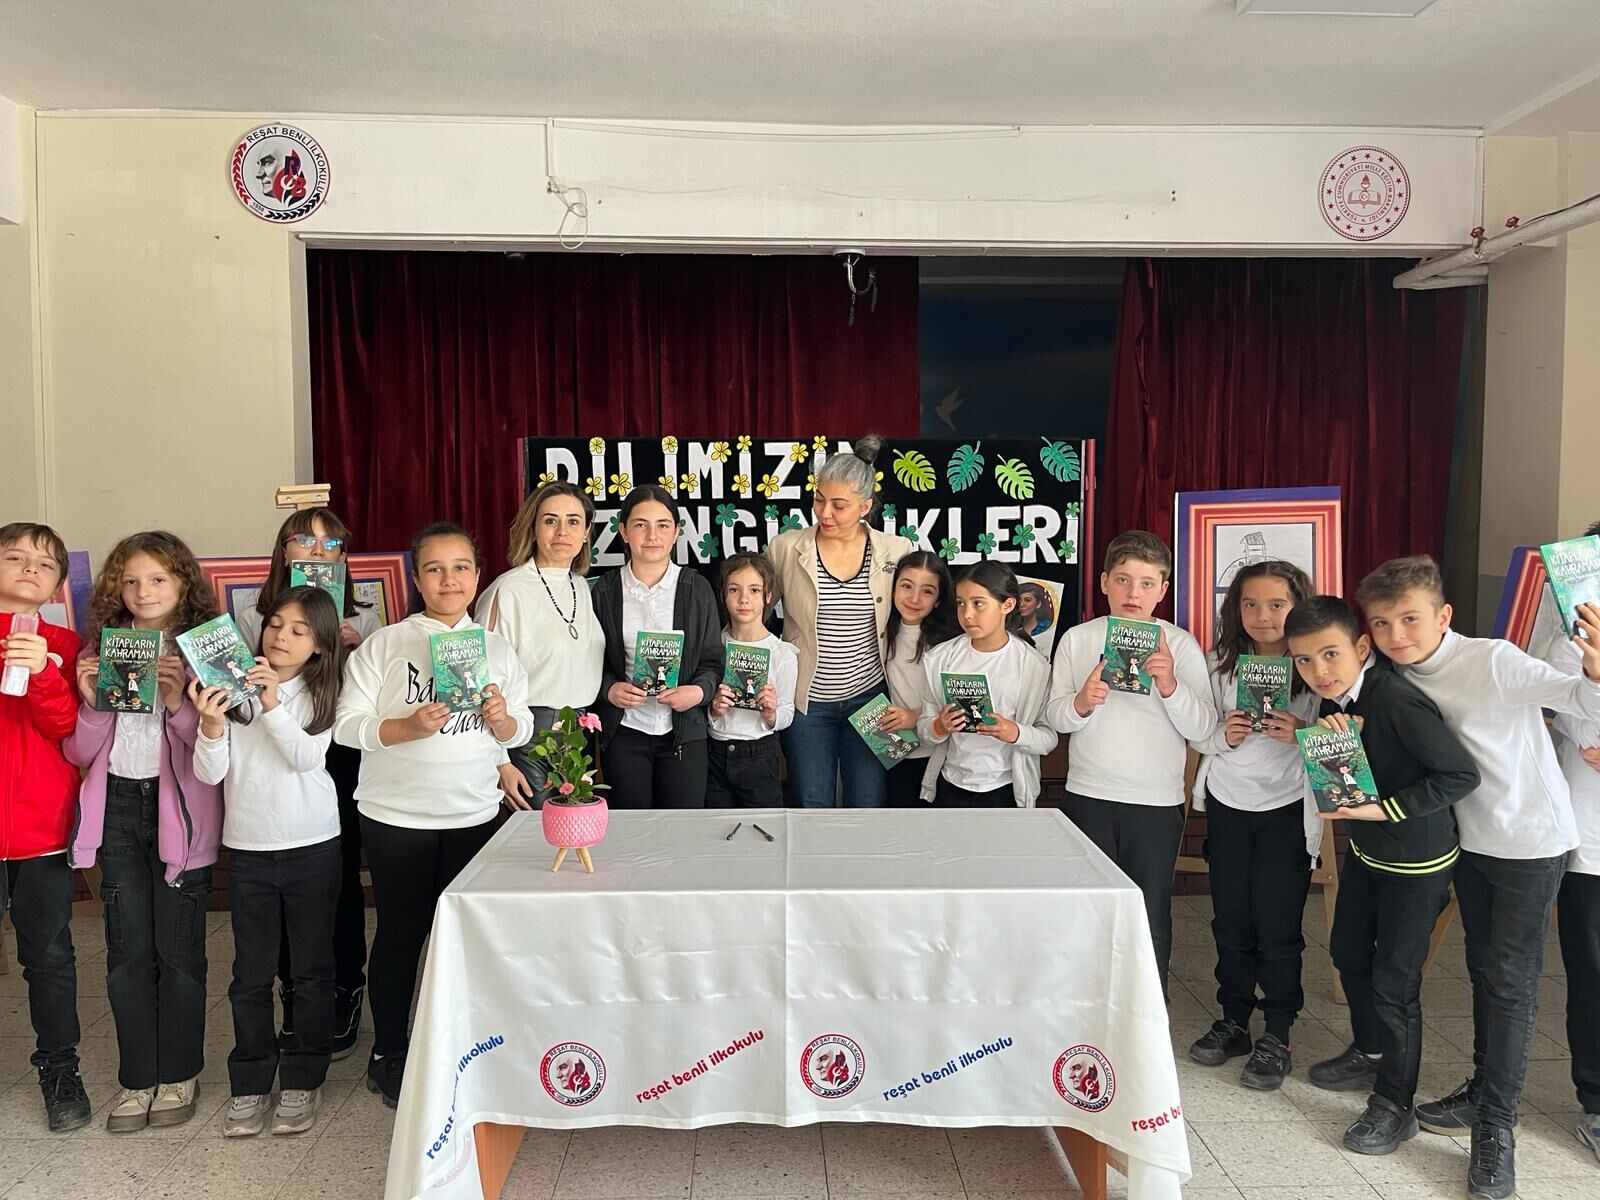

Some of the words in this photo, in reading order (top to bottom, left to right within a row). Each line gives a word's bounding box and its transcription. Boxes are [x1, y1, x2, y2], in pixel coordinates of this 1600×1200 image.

[246, 127, 279, 143] REŞAT
[281, 127, 312, 146] BENLİ
[309, 143, 327, 193] İLKOKULU
[545, 436, 857, 501] DİLİMİZİ
[187, 624, 233, 650] KİTAPLARIN
[1112, 624, 1157, 640] KİTAPLARIN
[106, 635, 156, 649] KİTAPLARIN
[192, 633, 239, 660] KAHRAMANI
[437, 638, 481, 652] KİTAPLARIN
[641, 636, 681, 648] KİTAPLARIN
[1110, 635, 1155, 649] KAHRAMANI
[105, 648, 155, 659] KAHRAMANI
[438, 647, 483, 661] KAHRAMANI
[640, 646, 680, 656] KAHRAMANI
[730, 649, 768, 662] KİTAPLARIN
[729, 657, 767, 670] KAHRAMANI
[1242, 661, 1287, 674] KİTAPLARIN
[945, 678, 986, 689] KİTAPLARIN
[1242, 673, 1287, 685] KAHRAMANI
[947, 686, 987, 696] KAHRAMANI
[1303, 728, 1355, 748] KİTAPLARIN
[1306, 739, 1359, 758] KAHRAMANI
[549, 1045, 569, 1056] REŞAT
[570, 1045, 588, 1054] BENLİ
[588, 1051, 604, 1081] İLKOKULU
[812, 1037, 831, 1048] REŞAT
[832, 1036, 851, 1046] BENLİ
[850, 1043, 863, 1075] İLKOKULU
[636, 1080, 672, 1103] reşat
[672, 1059, 709, 1086] benli
[708, 1030, 764, 1066] ilkokulu
[883, 1077, 921, 1101] reşat
[921, 1060, 958, 1084] benli
[958, 1037, 1013, 1068] ilkokulu
[1065, 1047, 1085, 1057] REŞAT
[1086, 1048, 1103, 1061] BENLİ
[1101, 1060, 1113, 1096] İLKOKULU
[1131, 1111, 1170, 1133] reşat
